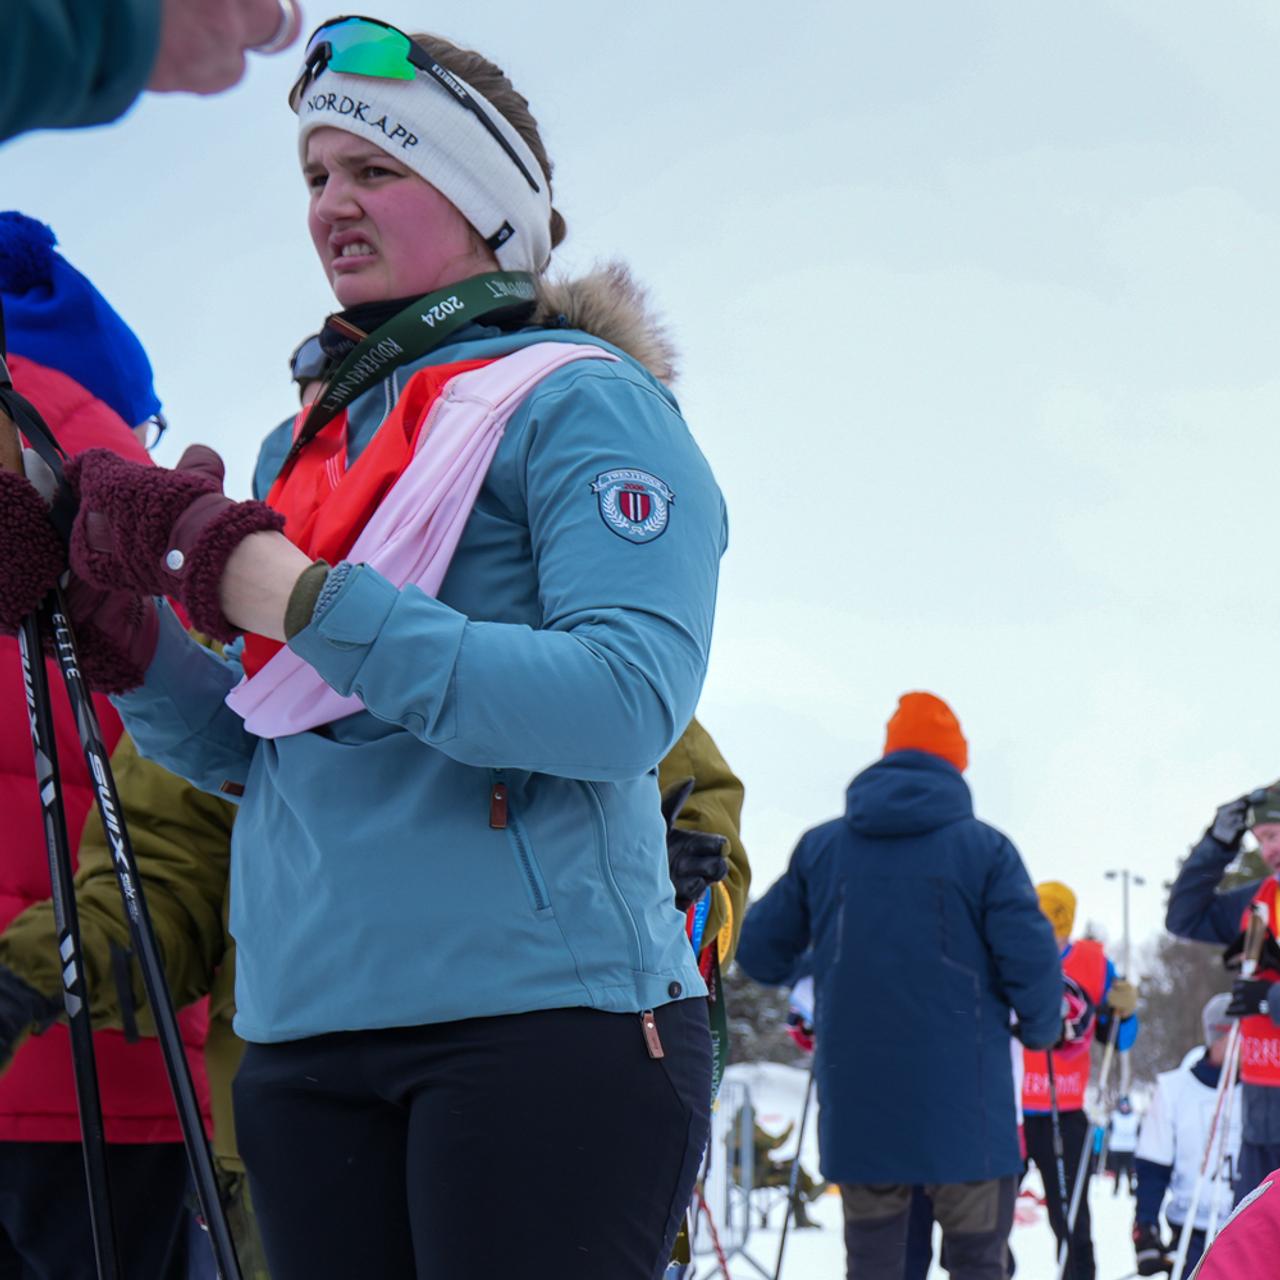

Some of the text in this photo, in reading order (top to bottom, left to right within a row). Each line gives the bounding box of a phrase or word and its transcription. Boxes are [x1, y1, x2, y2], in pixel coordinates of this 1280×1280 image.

[307, 93, 418, 150] NORDKAPP
[422, 296, 465, 328] 2024
[53, 613, 80, 680] ELITE
[88, 751, 129, 871] SWIX
